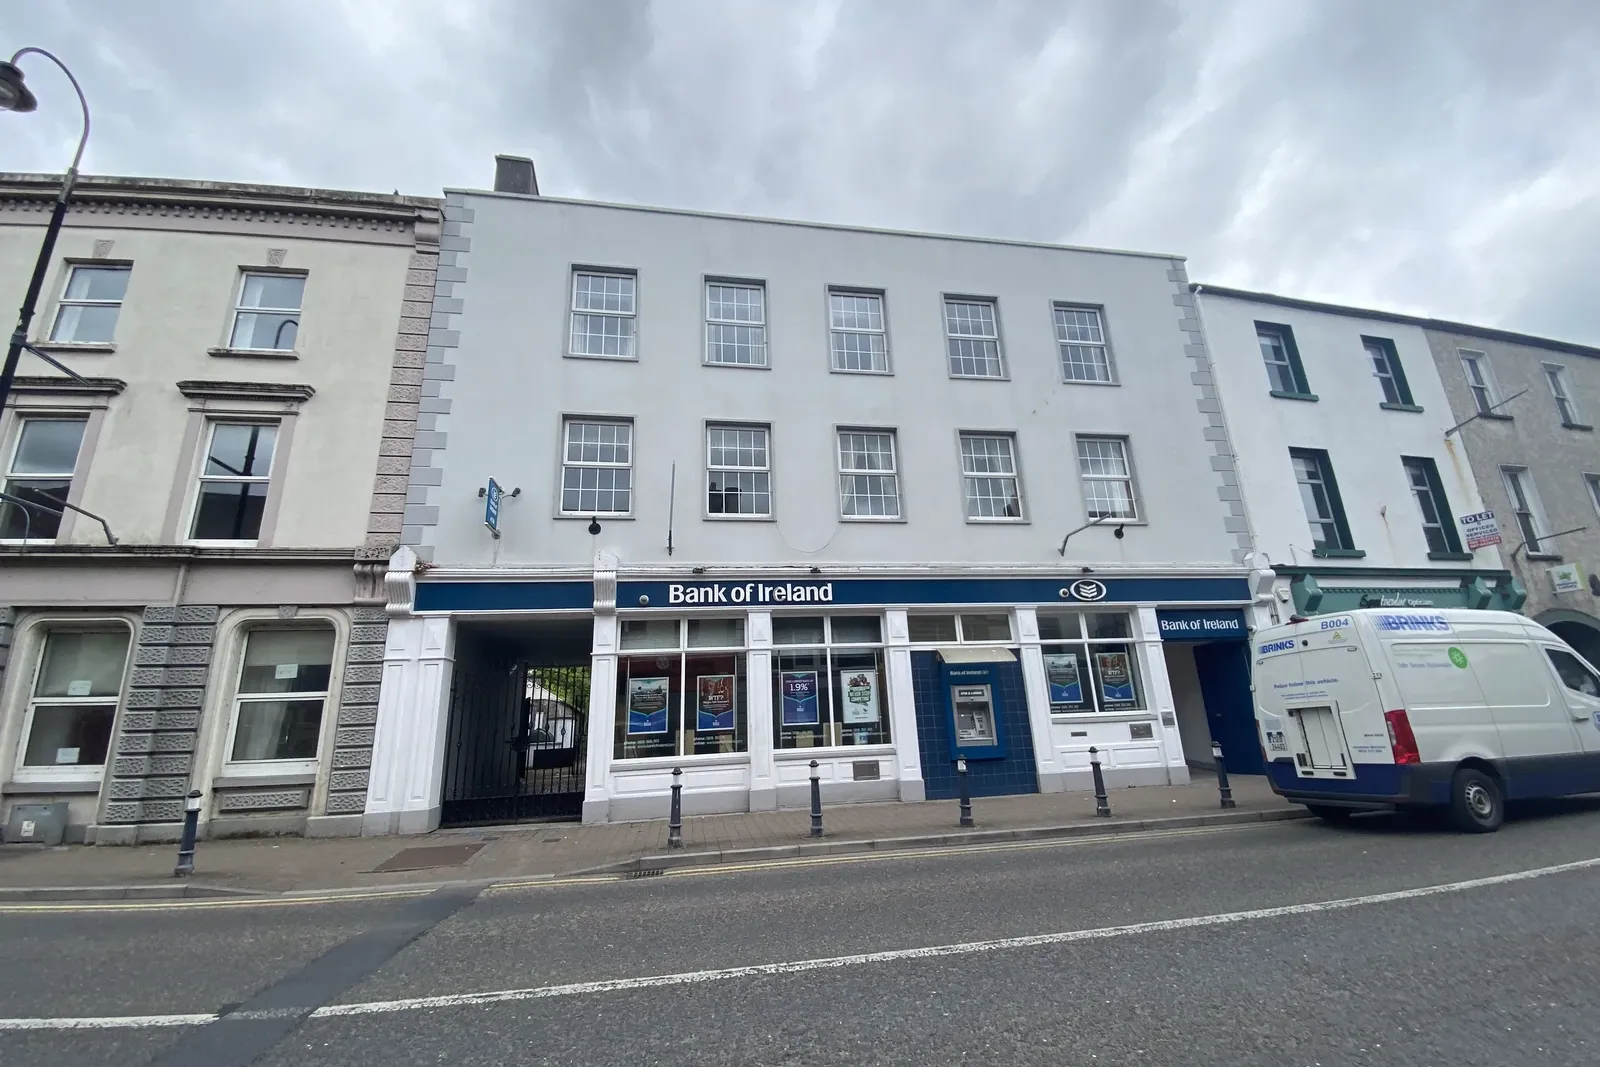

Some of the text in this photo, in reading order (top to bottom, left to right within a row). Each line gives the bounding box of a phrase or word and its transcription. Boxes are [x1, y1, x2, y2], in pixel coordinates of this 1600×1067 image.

[1462, 511, 1493, 524] TO LET
[1466, 523, 1495, 533] OFFICES
[1466, 528, 1498, 538] SERVICED
[669, 582, 833, 604] Bank of Ireland
[1161, 618, 1239, 631] Bank of Ireland
[1321, 618, 1349, 630] B004
[1378, 615, 1450, 631] BRINKS
[1260, 639, 1295, 654] BRINKS
